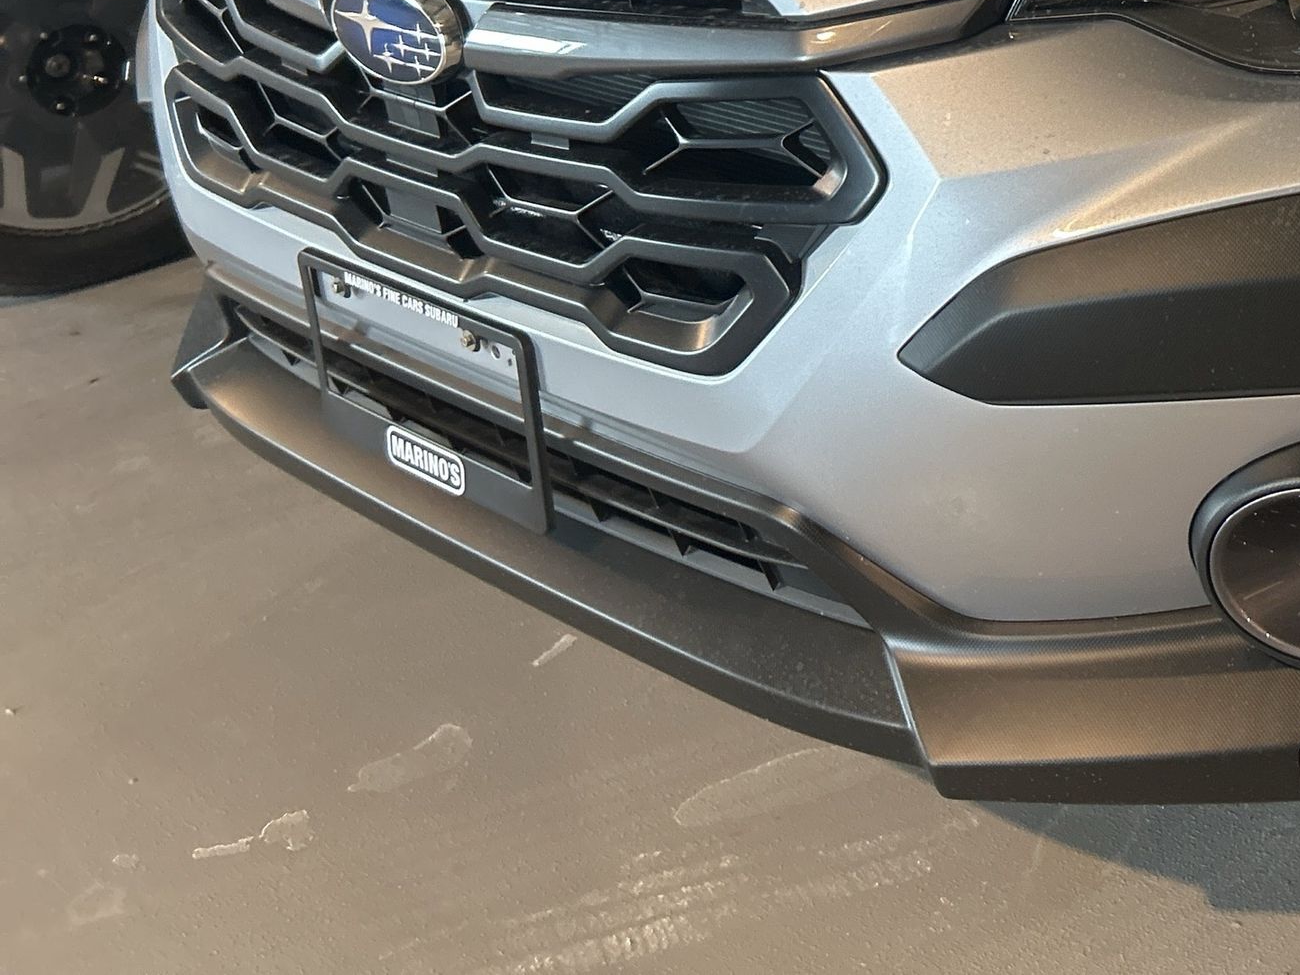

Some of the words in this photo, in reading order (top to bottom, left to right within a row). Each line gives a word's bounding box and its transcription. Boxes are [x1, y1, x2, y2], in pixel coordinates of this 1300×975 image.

[343, 271, 382, 297] MARINO'S
[382, 287, 401, 305] FINE
[401, 294, 424, 314] CARS
[424, 304, 459, 328] SUBARU
[391, 434, 461, 487] MARINO'S
